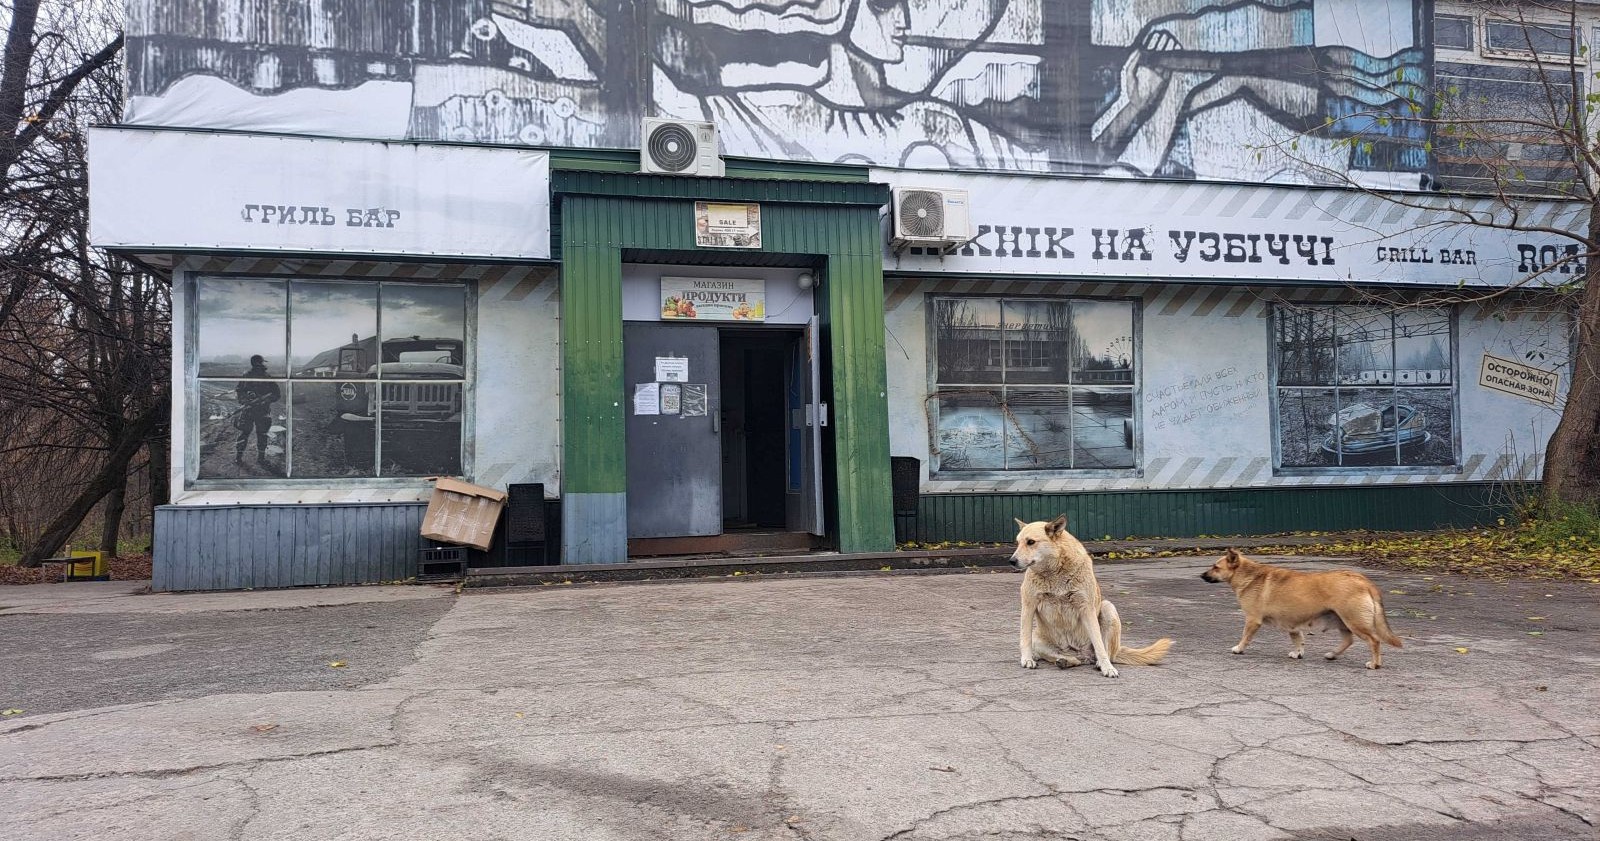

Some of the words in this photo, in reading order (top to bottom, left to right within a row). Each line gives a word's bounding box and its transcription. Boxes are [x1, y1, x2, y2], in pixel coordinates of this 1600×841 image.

[241, 204, 336, 226] ГРИЛЬ
[346, 207, 400, 228] БАР
[910, 225, 1075, 259] КНІК
[1092, 227, 1153, 261] НА
[1168, 230, 1335, 266] УЗБІЧЧІ
[1377, 246, 1433, 263] GRILL
[1440, 249, 1477, 265] BAR
[693, 281, 734, 289] МАГАЗИН
[682, 291, 747, 303] ПРОДУКТИ
[1146, 381, 1190, 403] СЧАСТЬЕ
[1194, 373, 1212, 387] ДЛЯ
[1215, 366, 1239, 380] ВСЕХ
[1487, 362, 1553, 387] ОСТОРОЖНО!
[1200, 384, 1233, 400] ПУСТЬ
[1485, 375, 1526, 391] ОПАСНАЯ
[1527, 385, 1550, 397] ЗОНА
